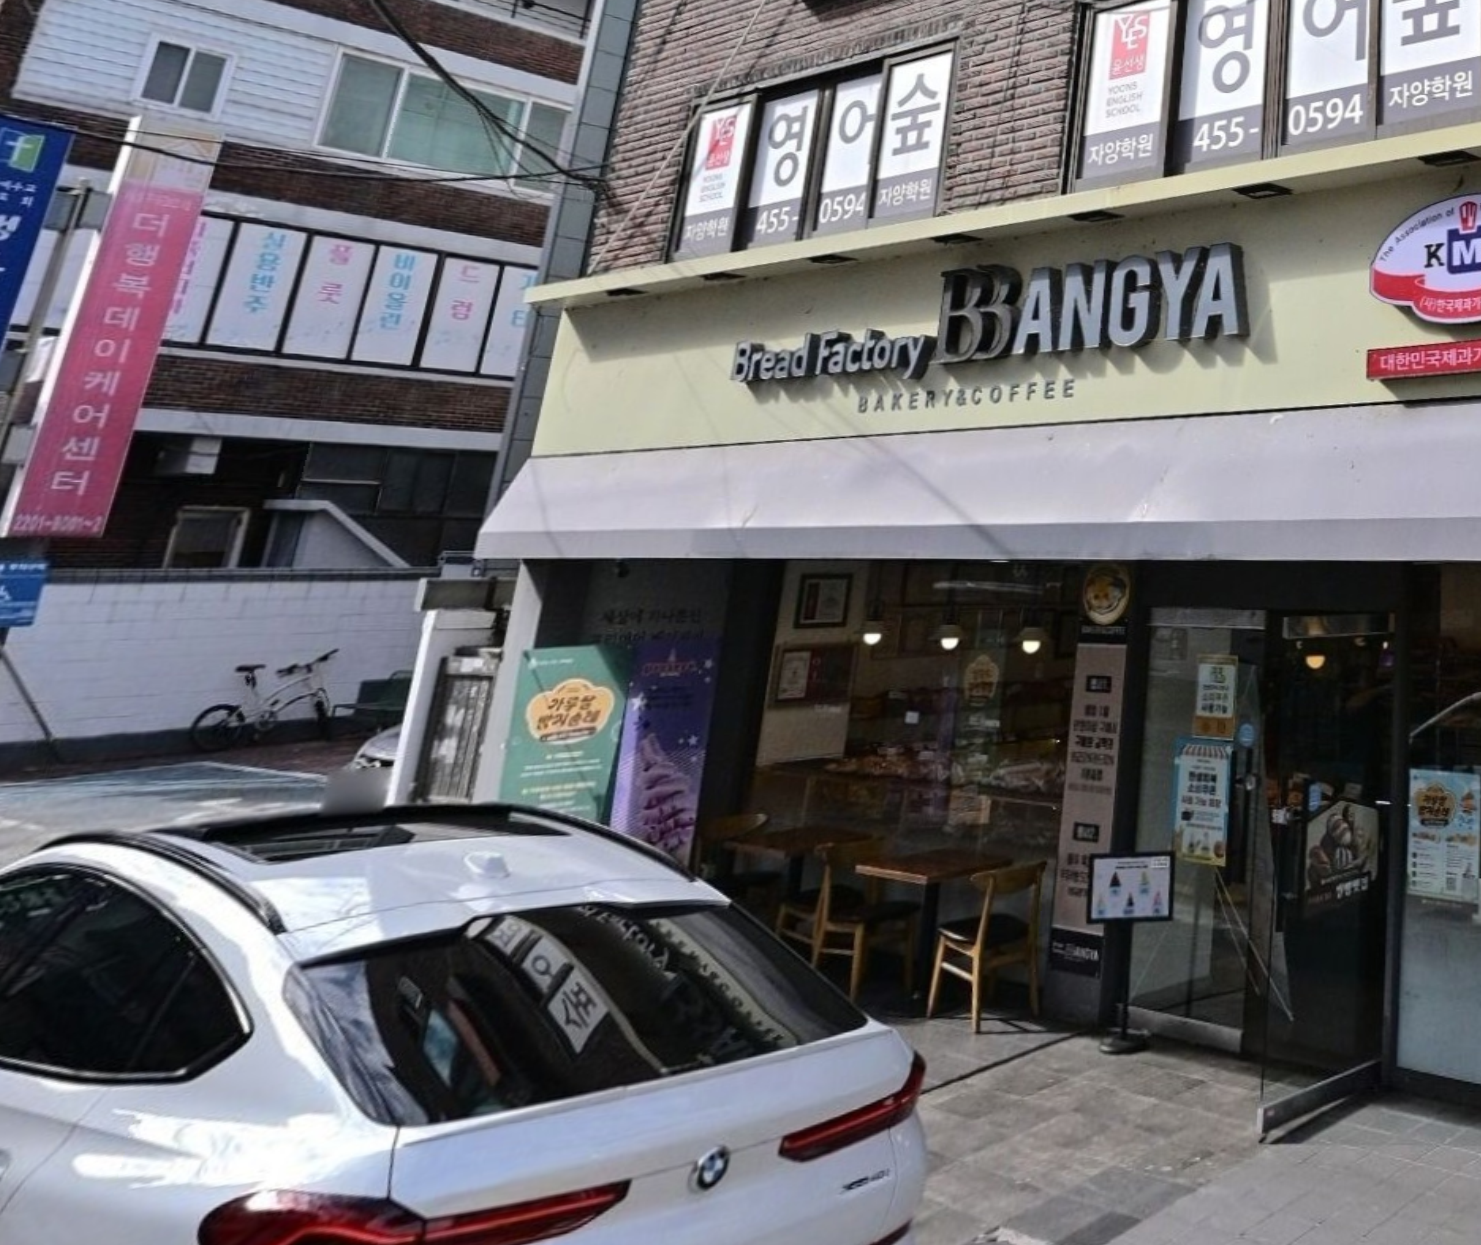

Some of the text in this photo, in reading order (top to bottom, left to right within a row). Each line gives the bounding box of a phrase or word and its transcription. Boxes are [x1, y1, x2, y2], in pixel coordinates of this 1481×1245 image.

[1114, 13, 1149, 51] YES
[1111, 54, 1145, 76] 윤선생
[1388, 70, 1473, 110] 자양학원
[1088, 133, 1153, 165] 자양학원
[878, 178, 932, 206] 자양학원
[684, 216, 730, 242] 자양학원
[1394, 212, 1443, 244] Association
[1445, 207, 1456, 219] of
[451, 264, 480, 321] 드럼
[932, 241, 1250, 364] BBANGYA
[730, 328, 937, 383] Bread Factory
[857, 377, 1077, 414] BAKERY&COFFEE
